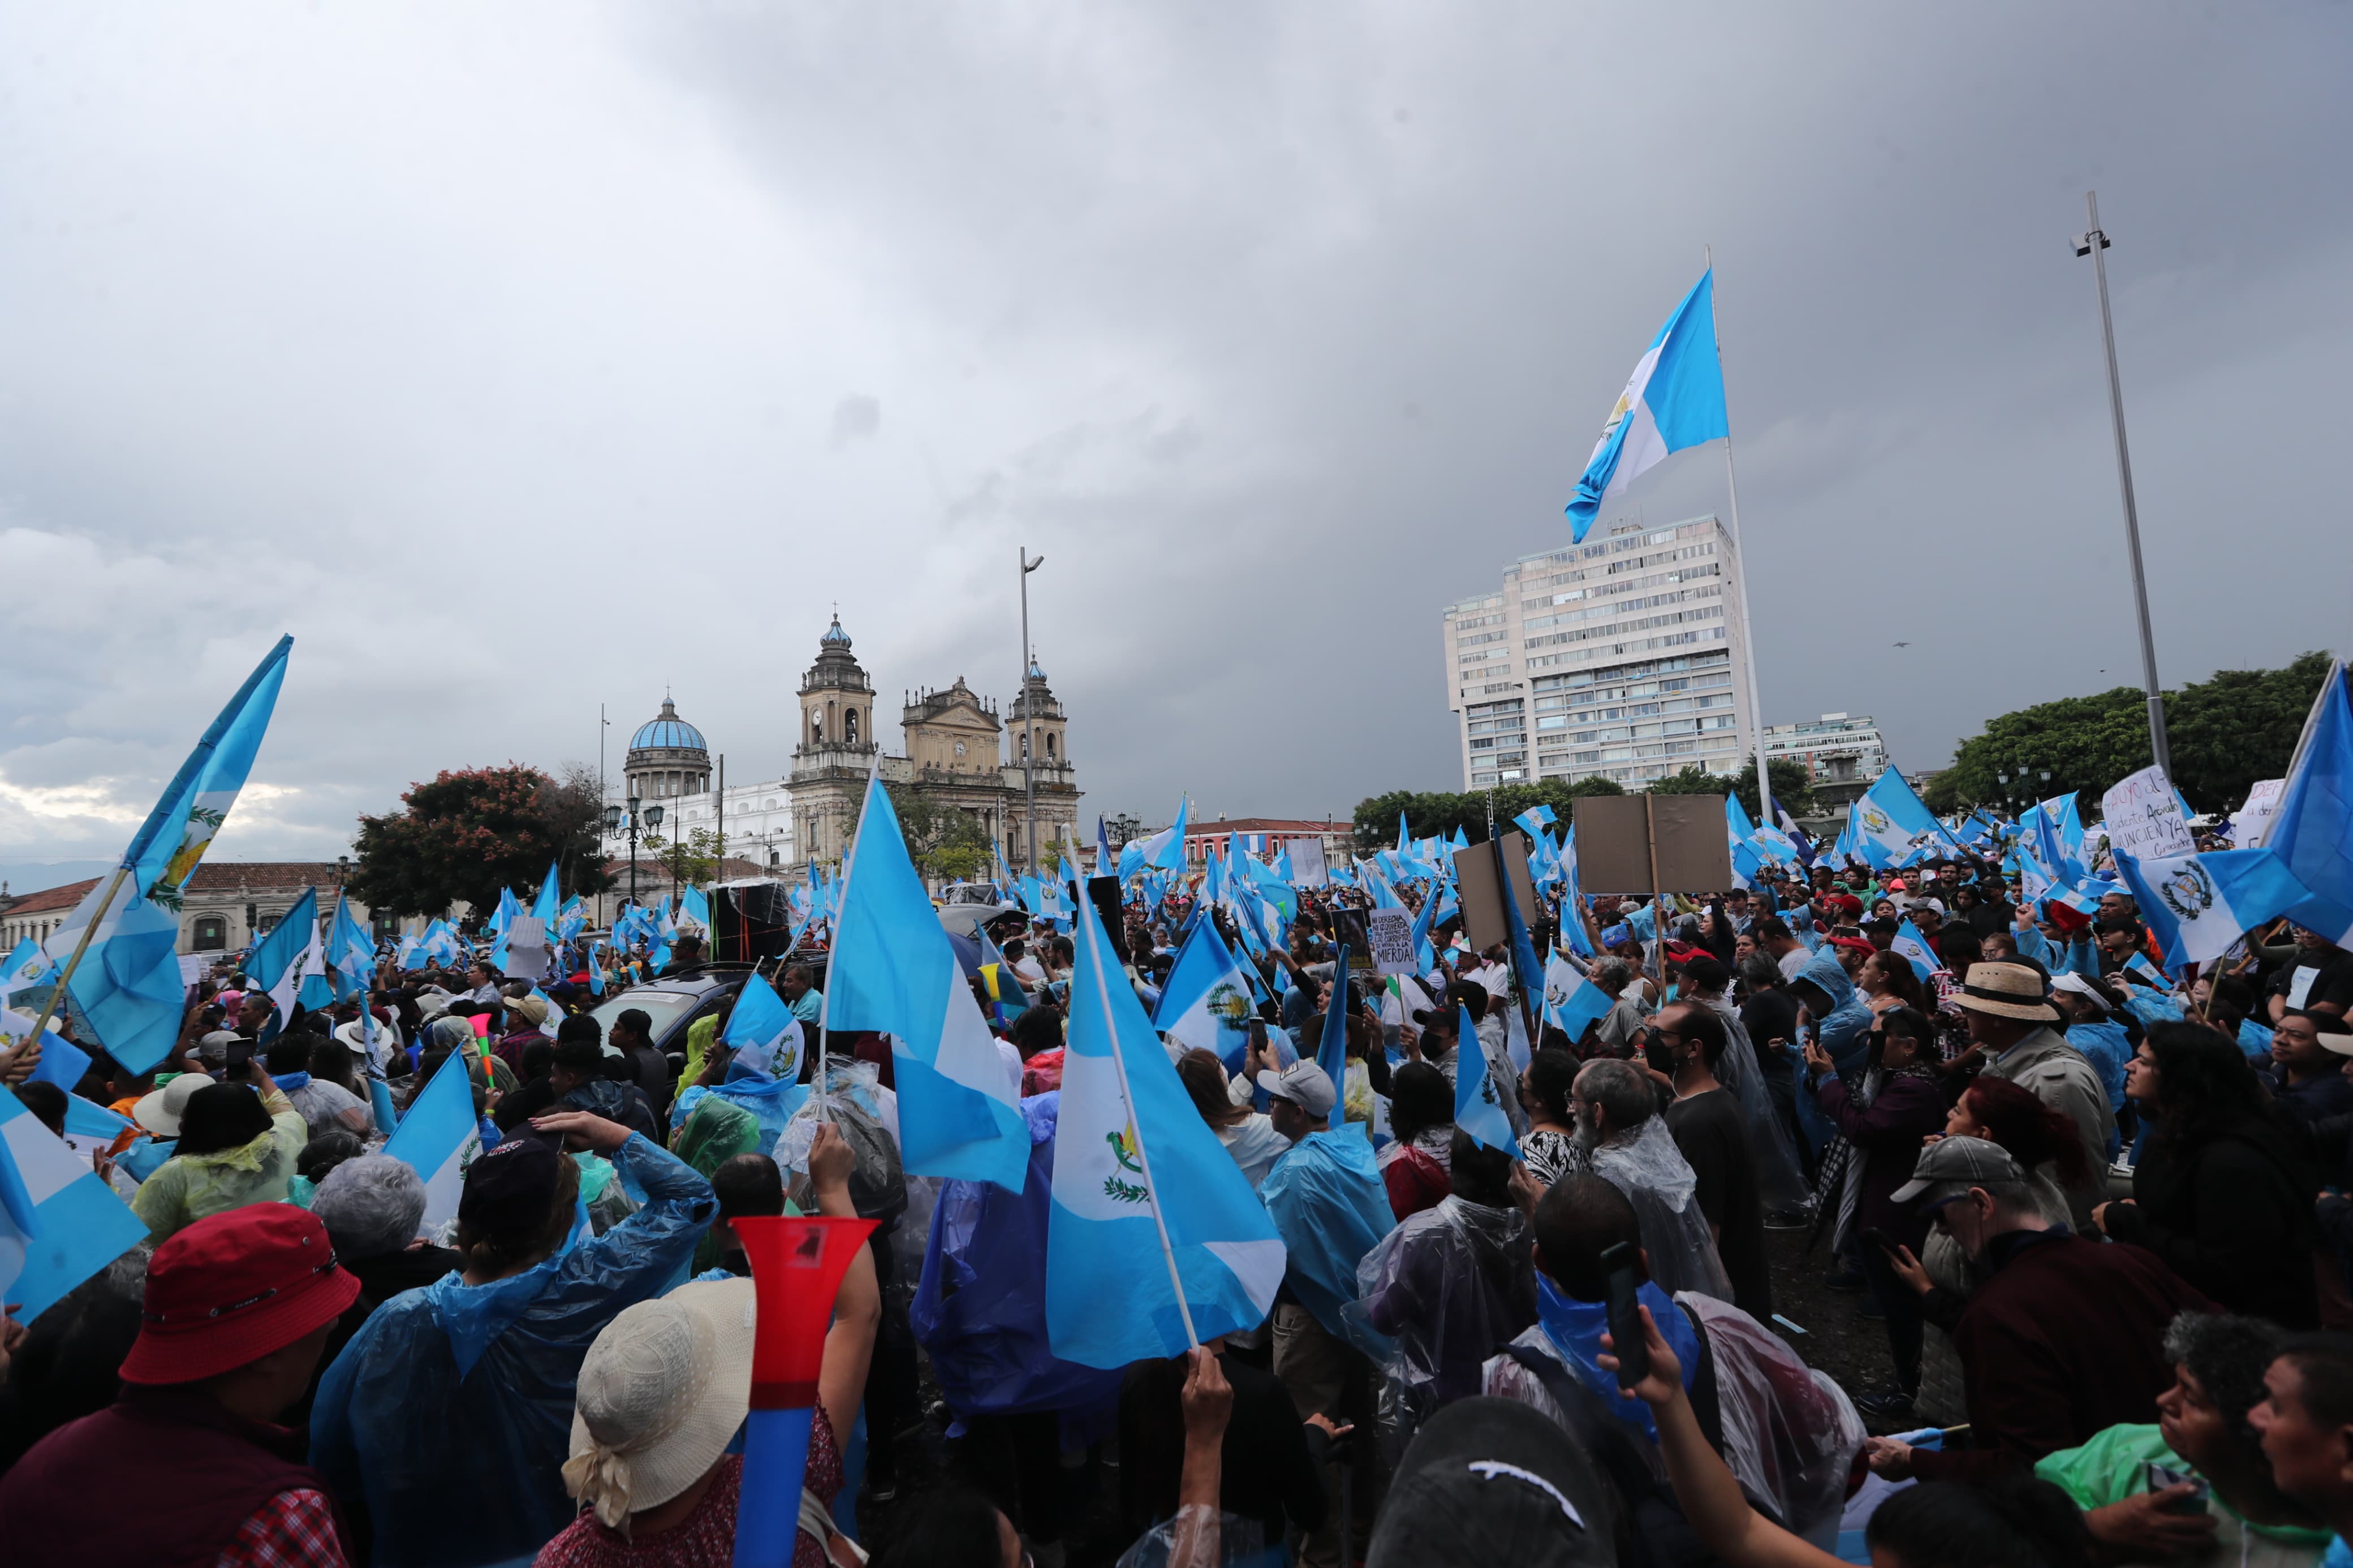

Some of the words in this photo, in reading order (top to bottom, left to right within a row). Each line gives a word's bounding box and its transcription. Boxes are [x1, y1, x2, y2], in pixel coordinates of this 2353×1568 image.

[2145, 773, 2161, 794] al
[2165, 817, 2187, 840] YA
[1384, 933, 1412, 943] CORRUPTOS
[1377, 947, 1413, 964] MIERDA!
